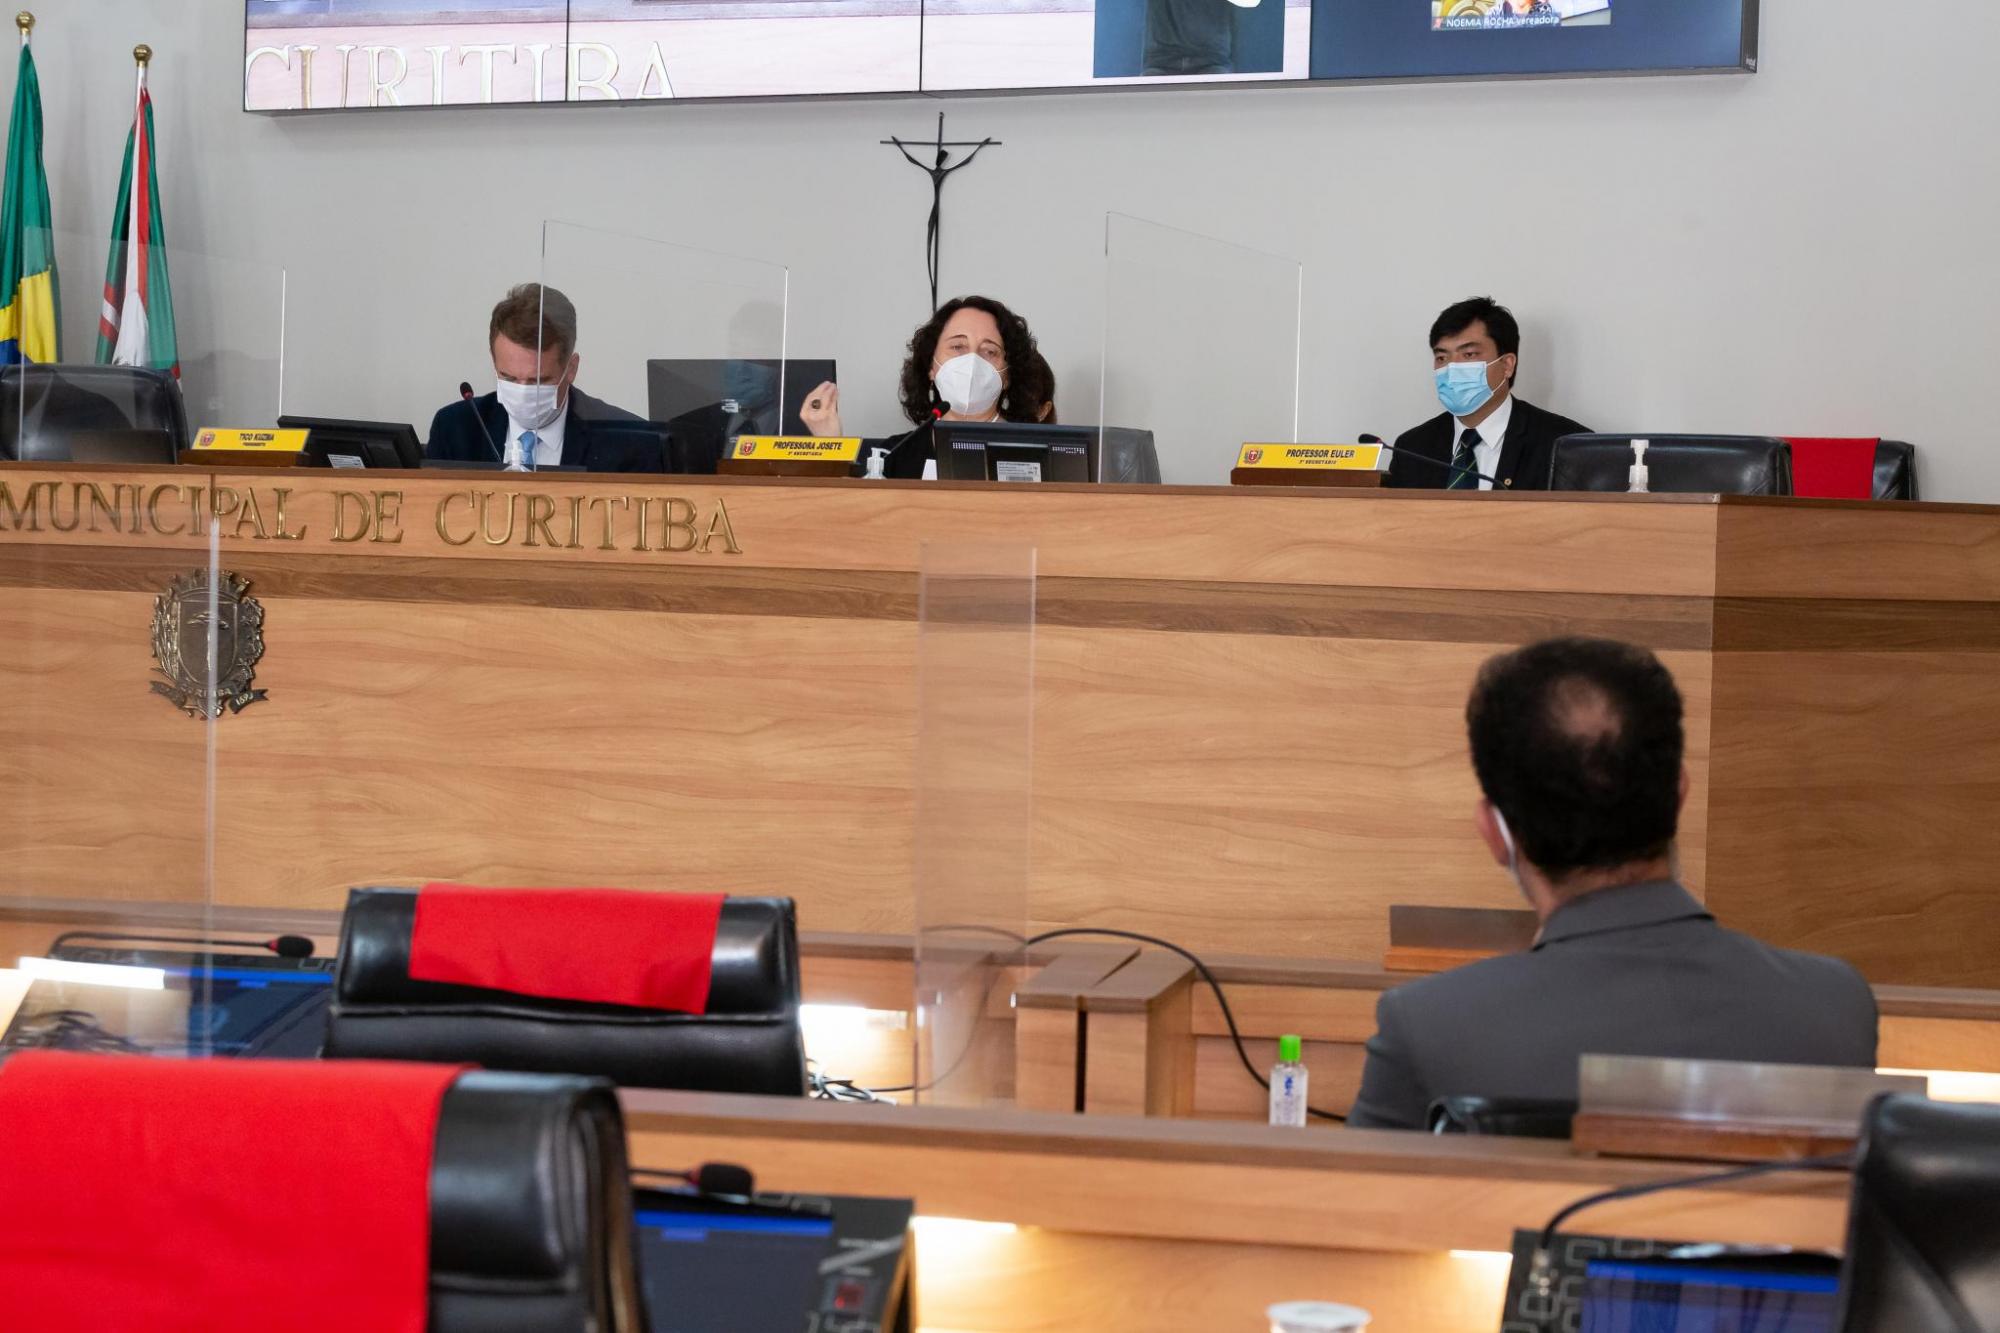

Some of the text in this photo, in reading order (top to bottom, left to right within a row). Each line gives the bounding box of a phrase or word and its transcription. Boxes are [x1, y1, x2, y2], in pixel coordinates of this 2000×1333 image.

[1446, 15, 1560, 28] NOEMIA ROCHA vereadora
[246, 41, 676, 110] CURITIBA
[773, 441, 843, 450] PROFESSORA JOSETE
[1286, 449, 1355, 458] PROFESSOR EULER
[0, 480, 743, 554] MUNICIPAL DE CURITIBA
